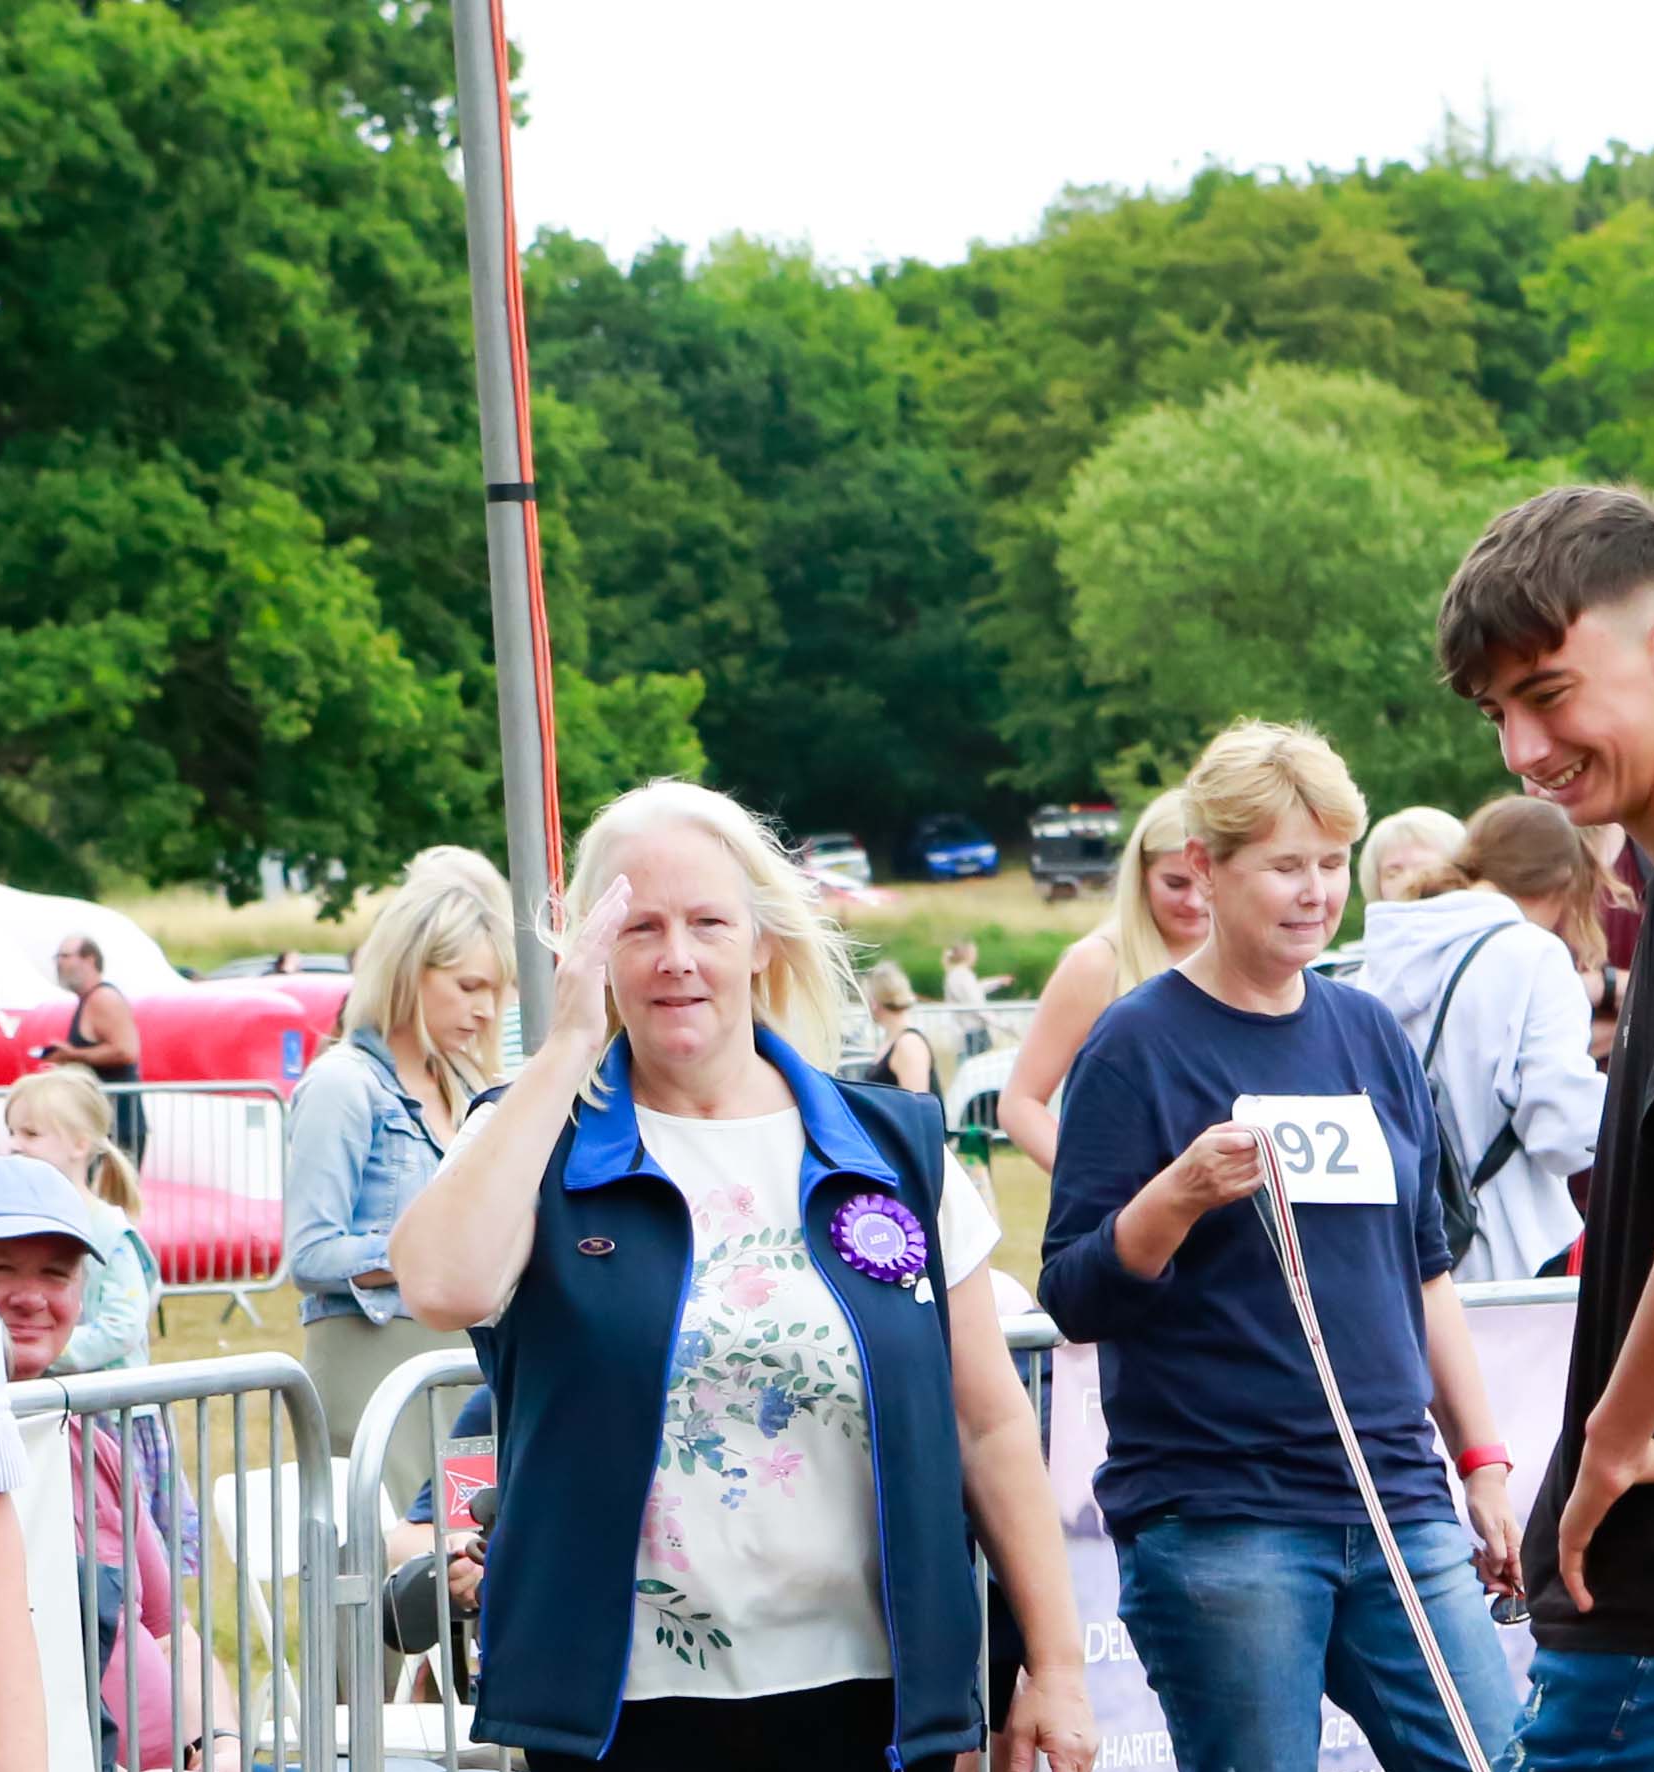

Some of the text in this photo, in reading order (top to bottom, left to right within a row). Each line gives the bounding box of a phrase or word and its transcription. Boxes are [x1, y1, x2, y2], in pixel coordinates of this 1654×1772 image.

[1272, 1121, 1360, 1175] 92
[1084, 1621, 1138, 1664] DEL
[1093, 1731, 1175, 1769] HARTE
